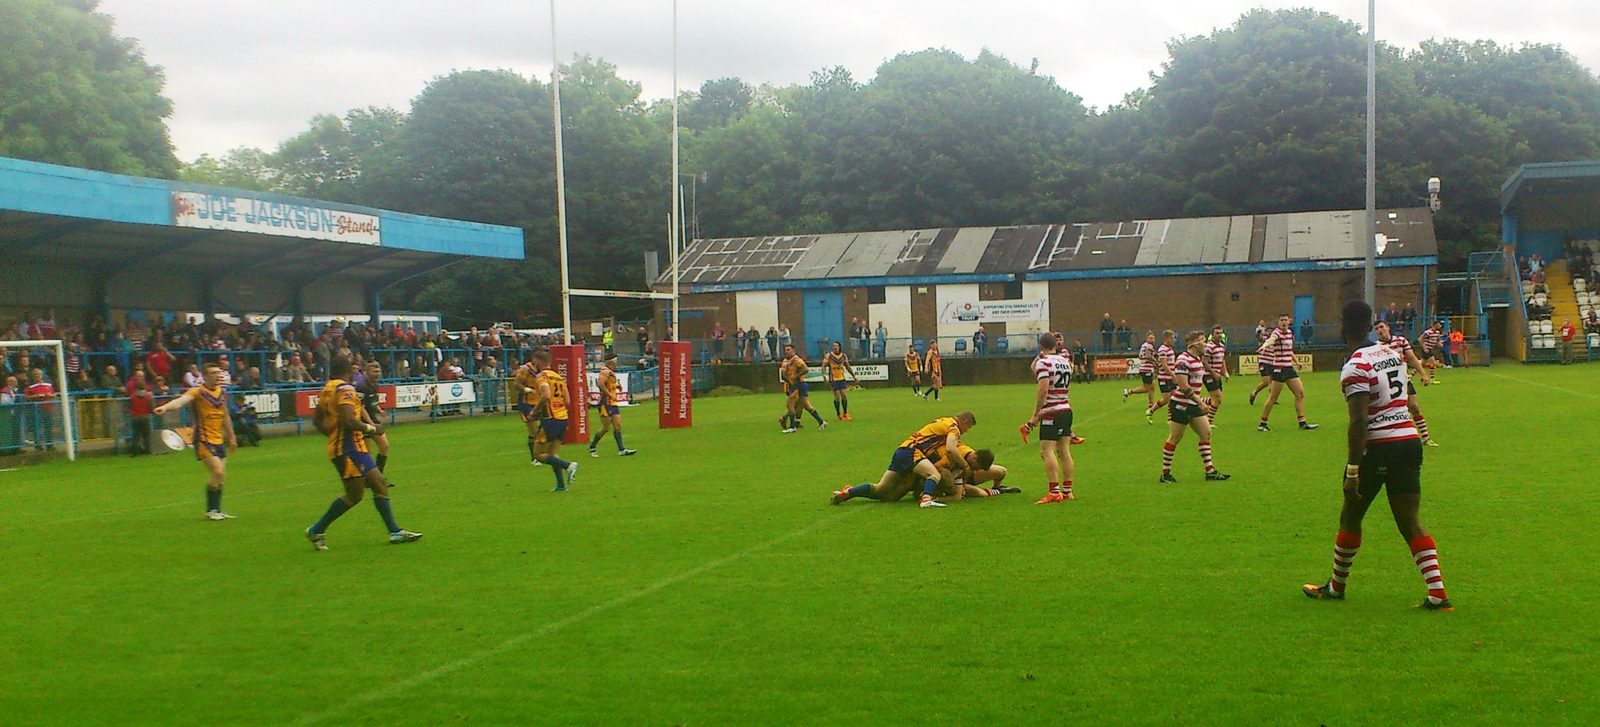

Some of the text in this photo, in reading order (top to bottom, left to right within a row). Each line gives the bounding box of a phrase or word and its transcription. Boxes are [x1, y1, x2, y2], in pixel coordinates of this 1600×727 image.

[198, 194, 237, 222] JOE
[245, 198, 333, 233] JACKSON
[663, 356, 671, 414] PROPER CIDER
[679, 378, 688, 419] Kingstone
[1054, 370, 1070, 389] 20
[1386, 370, 1403, 399] 5
